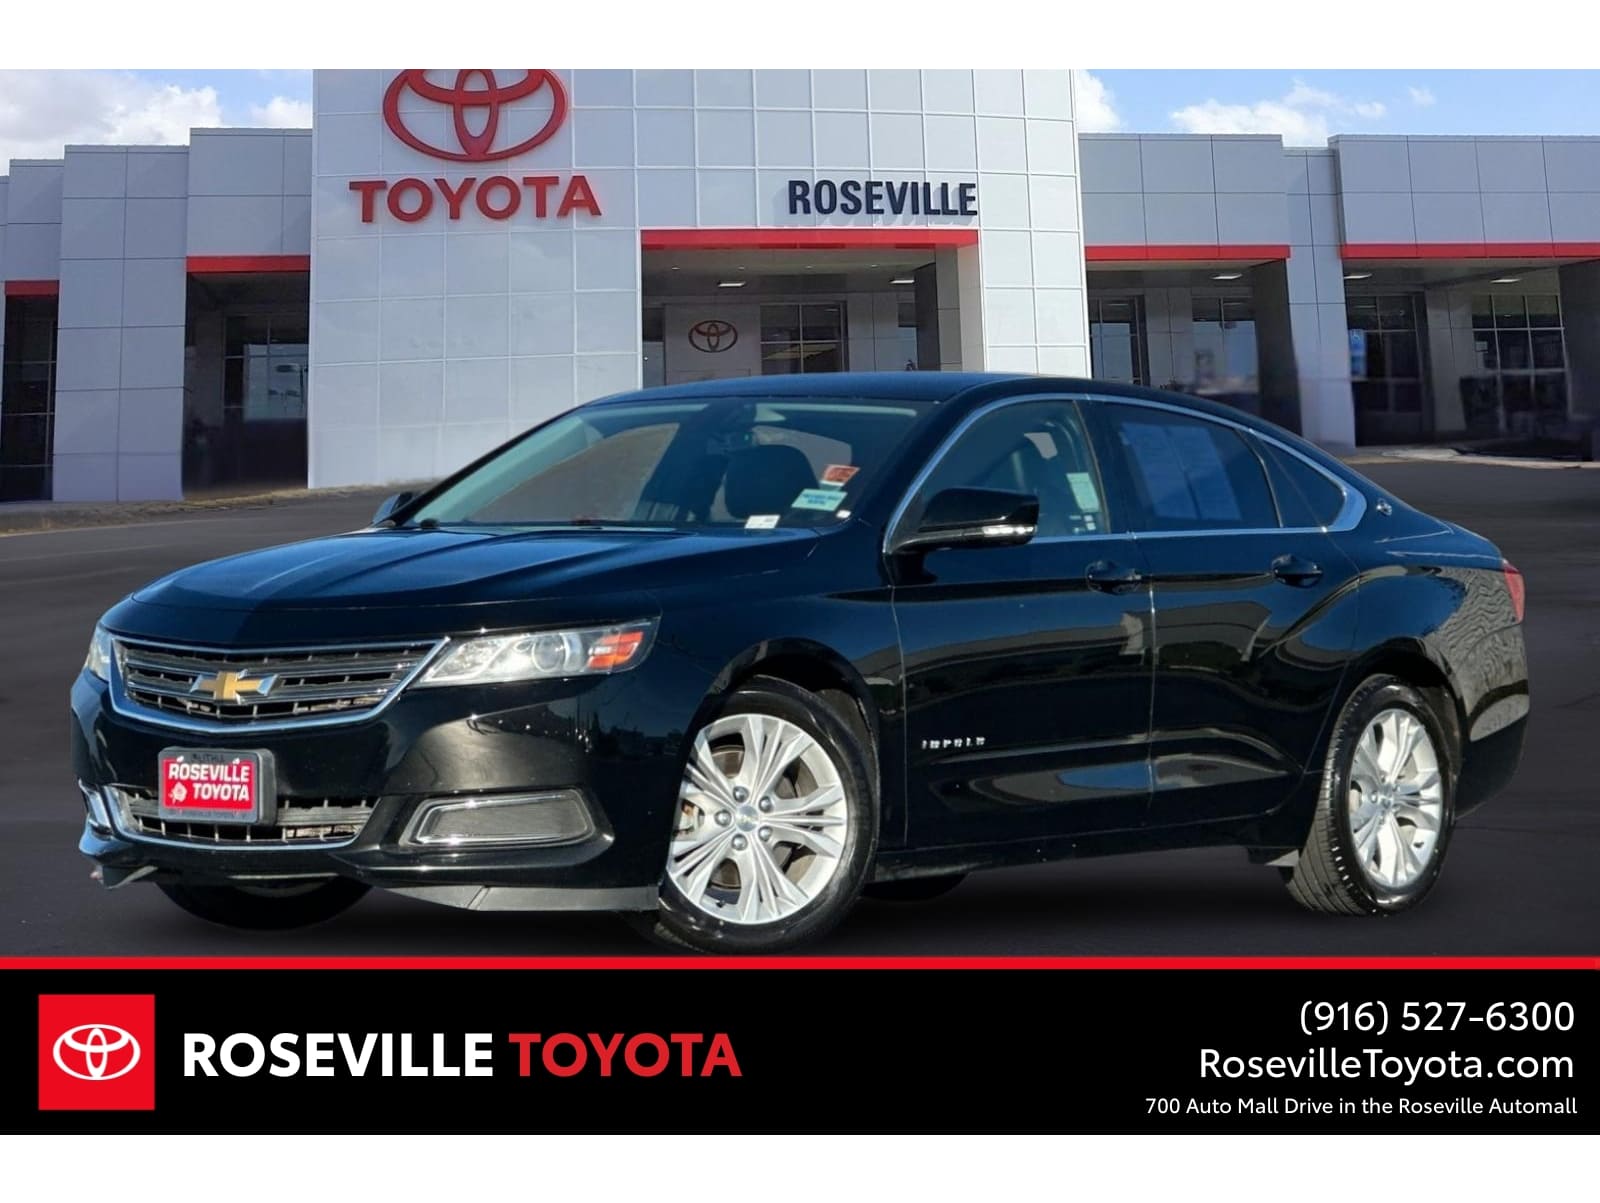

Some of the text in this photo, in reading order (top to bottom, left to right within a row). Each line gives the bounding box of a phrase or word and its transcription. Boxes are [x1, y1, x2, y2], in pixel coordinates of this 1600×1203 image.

[349, 175, 602, 223] TOYOTA
[788, 179, 978, 216] ROSEVILLE
[168, 763, 251, 783] ROSEVILLE
[192, 782, 250, 802] TOYOTA
